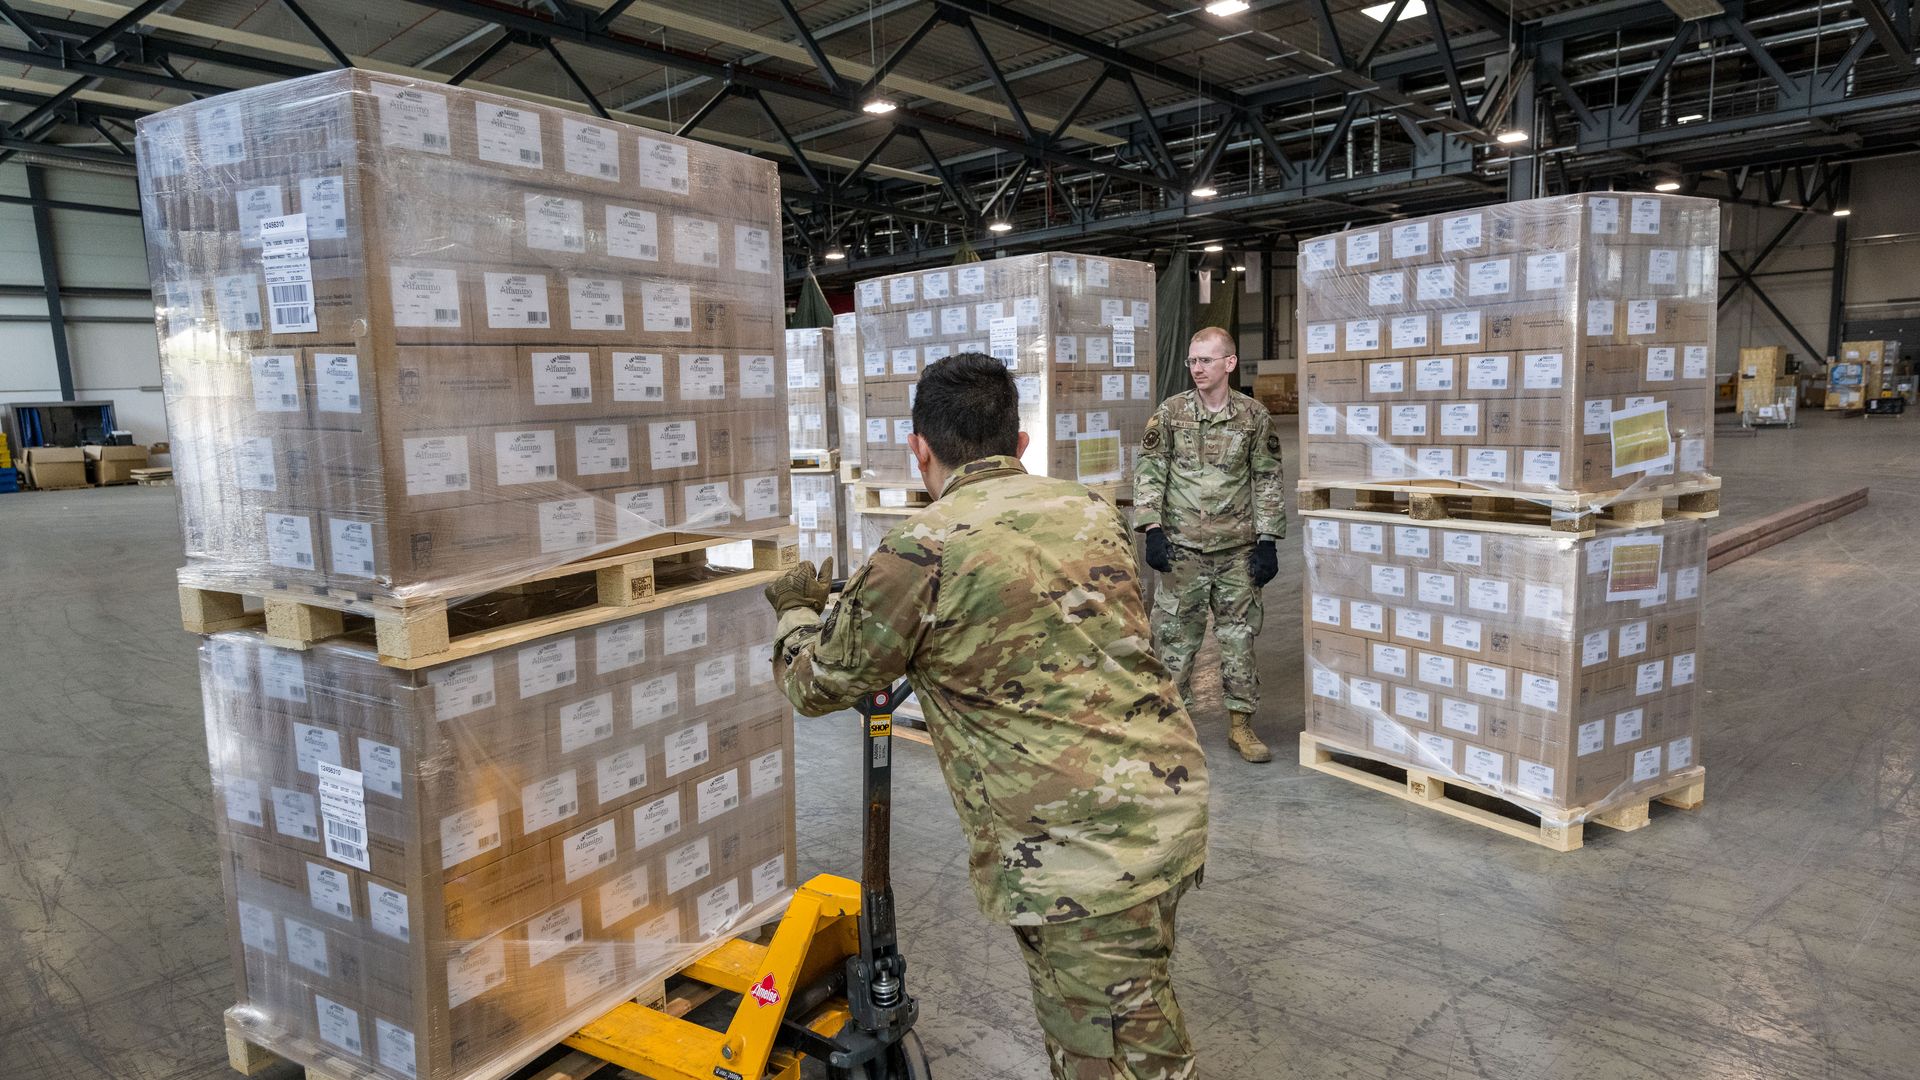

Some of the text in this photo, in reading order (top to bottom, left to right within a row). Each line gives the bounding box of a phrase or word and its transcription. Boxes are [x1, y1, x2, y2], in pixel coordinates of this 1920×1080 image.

[500, 285, 532, 295] Alfamino
[545, 364, 576, 373] Alfamino
[624, 364, 651, 372] Alfamino
[576, 836, 603, 850] Alfamino
[751, 984, 777, 1002] Ameise
